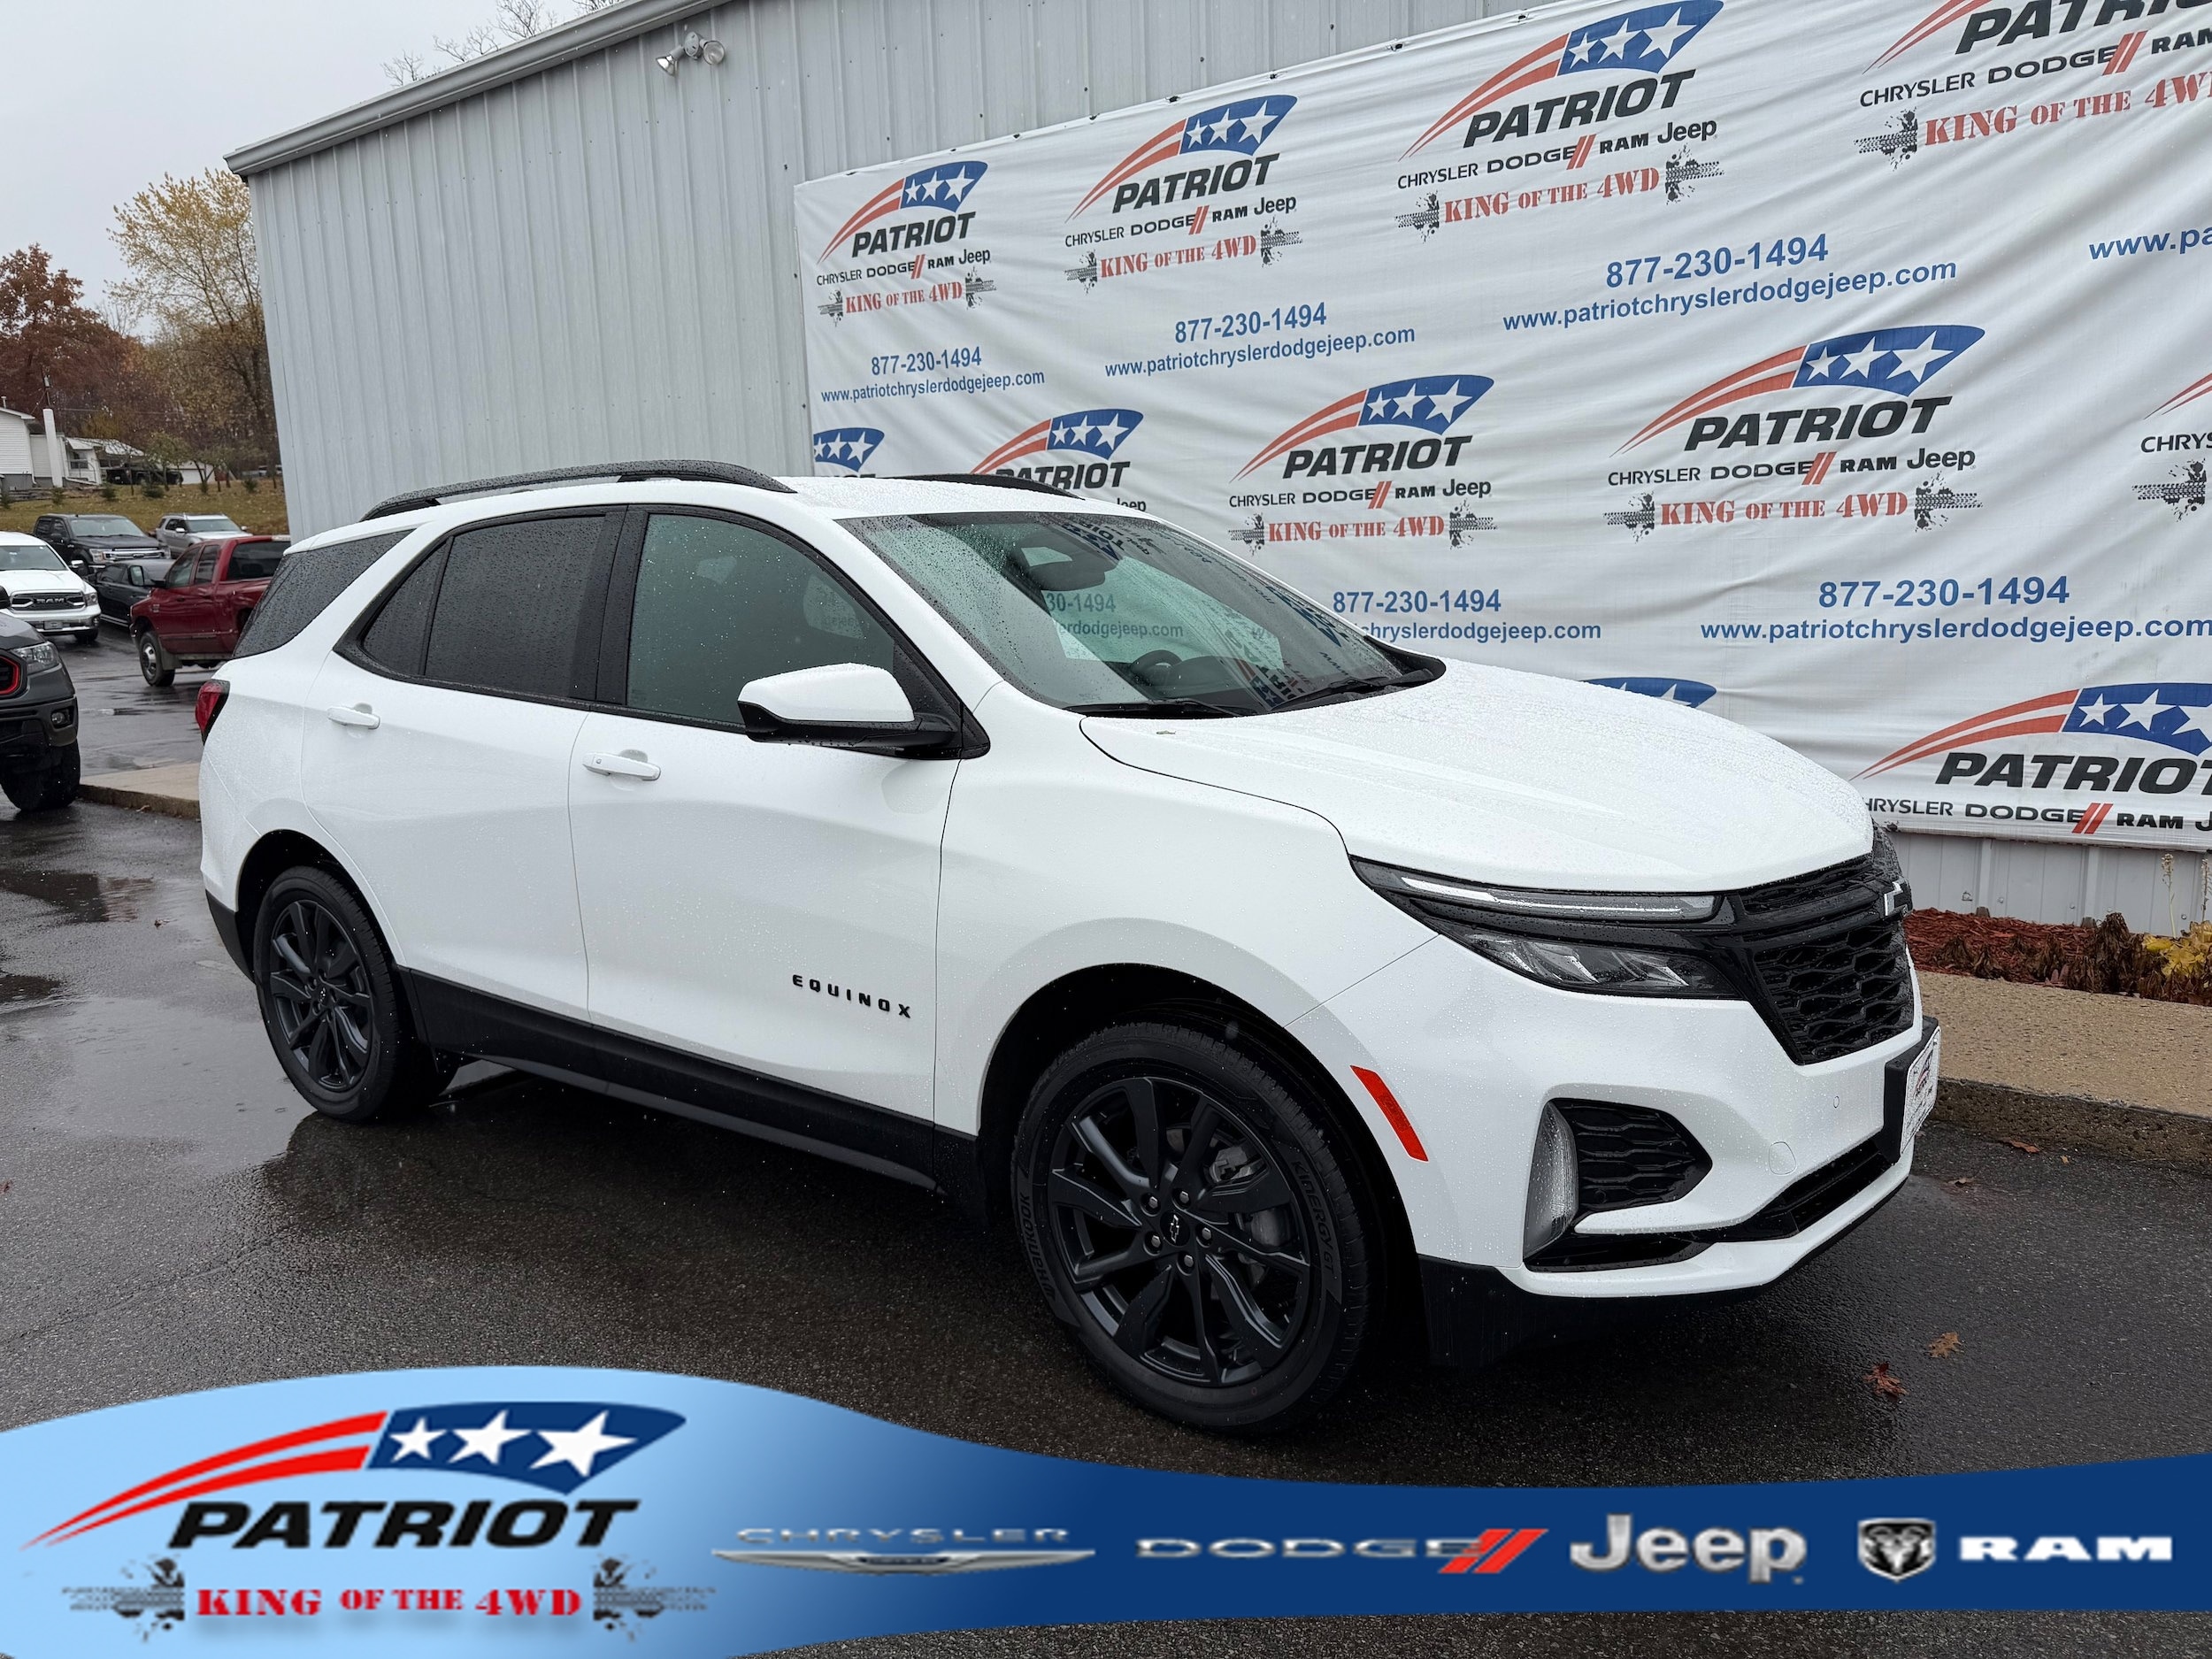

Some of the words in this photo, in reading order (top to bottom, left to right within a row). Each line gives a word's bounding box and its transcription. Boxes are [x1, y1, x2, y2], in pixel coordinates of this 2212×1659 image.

[1860, 72, 1975, 107] CHRYSLER
[1987, 45, 2119, 84] DODGE
[1463, 69, 1696, 149] PATRIOT
[1924, 105, 2017, 145] KING
[2030, 102, 2066, 127] OF
[2073, 90, 2131, 119] THE
[2145, 71, 2212, 108] 4W
[1397, 162, 1479, 189] CHRYSLER
[1487, 146, 1576, 173] DODGE
[1600, 133, 1649, 155] RAM
[1657, 118, 1717, 144] Jeep
[1112, 153, 1279, 213] PATRIOT
[1444, 194, 1509, 224] KING
[1517, 188, 1544, 210] OF
[1548, 182, 1587, 204] THE
[1597, 166, 1660, 198] 4WD
[852, 211, 976, 257] PATRIOT
[1065, 227, 1125, 247] CHRYSLER
[1131, 213, 1195, 236] DODGE
[1212, 205, 1248, 223] RAM
[1254, 196, 1296, 215] Jeep
[817, 269, 862, 286] CHRYSLER
[866, 261, 916, 278] DODGE
[927, 256, 954, 270] RAM
[958, 249, 991, 265] Jeep
[1101, 252, 1148, 278] KING
[1154, 252, 1171, 268] OF
[1175, 246, 1204, 265] THE
[1211, 234, 1256, 260] 4WD
[1606, 234, 1829, 288] 877-230-1494
[846, 293, 881, 313] KING
[886, 293, 899, 306] OF
[902, 289, 925, 304] THE
[929, 281, 963, 303] 4WD
[1503, 261, 1957, 331] www.patriotchryslerdodgejeep.com
[1175, 302, 1326, 343] 877-230-1494
[871, 346, 982, 376] 877-230-1494
[1105, 326, 1415, 377] www.patriotchryslerdodgejeep.com
[821, 369, 1045, 403] www.patriotchryslerdodgejeep.com
[1684, 396, 1953, 451] PATRIOT
[1282, 435, 1472, 479] PATRIOT
[1608, 467, 1701, 486] CHRYSLER
[1710, 461, 1814, 480] DODGE
[1839, 456, 1897, 472] RAM
[1907, 448, 1975, 472] Jeep
[1229, 493, 1295, 508] CHRYSLER
[1302, 488, 1376, 503] DODGE
[1394, 484, 1435, 499] RAM
[1442, 479, 1491, 497] Jeep
[1660, 500, 1735, 526] KING
[1746, 503, 1772, 519] OF
[1778, 500, 1825, 518] THE
[1835, 492, 1908, 518] 4WD
[1268, 521, 1322, 542] KING
[1329, 523, 1348, 538] OF
[1353, 522, 1386, 537] THE
[1393, 516, 1444, 537] 4WD
[1333, 589, 1502, 613] 877-230-1494
[1818, 576, 2070, 609] 877-230-1494
[1701, 616, 2212, 643] www.patriotchryslerdodgejeep.com
[1965, 803, 2085, 823] DODGE
[2116, 813, 2184, 829] RAM
[793, 974, 910, 1018] EQUINOX
